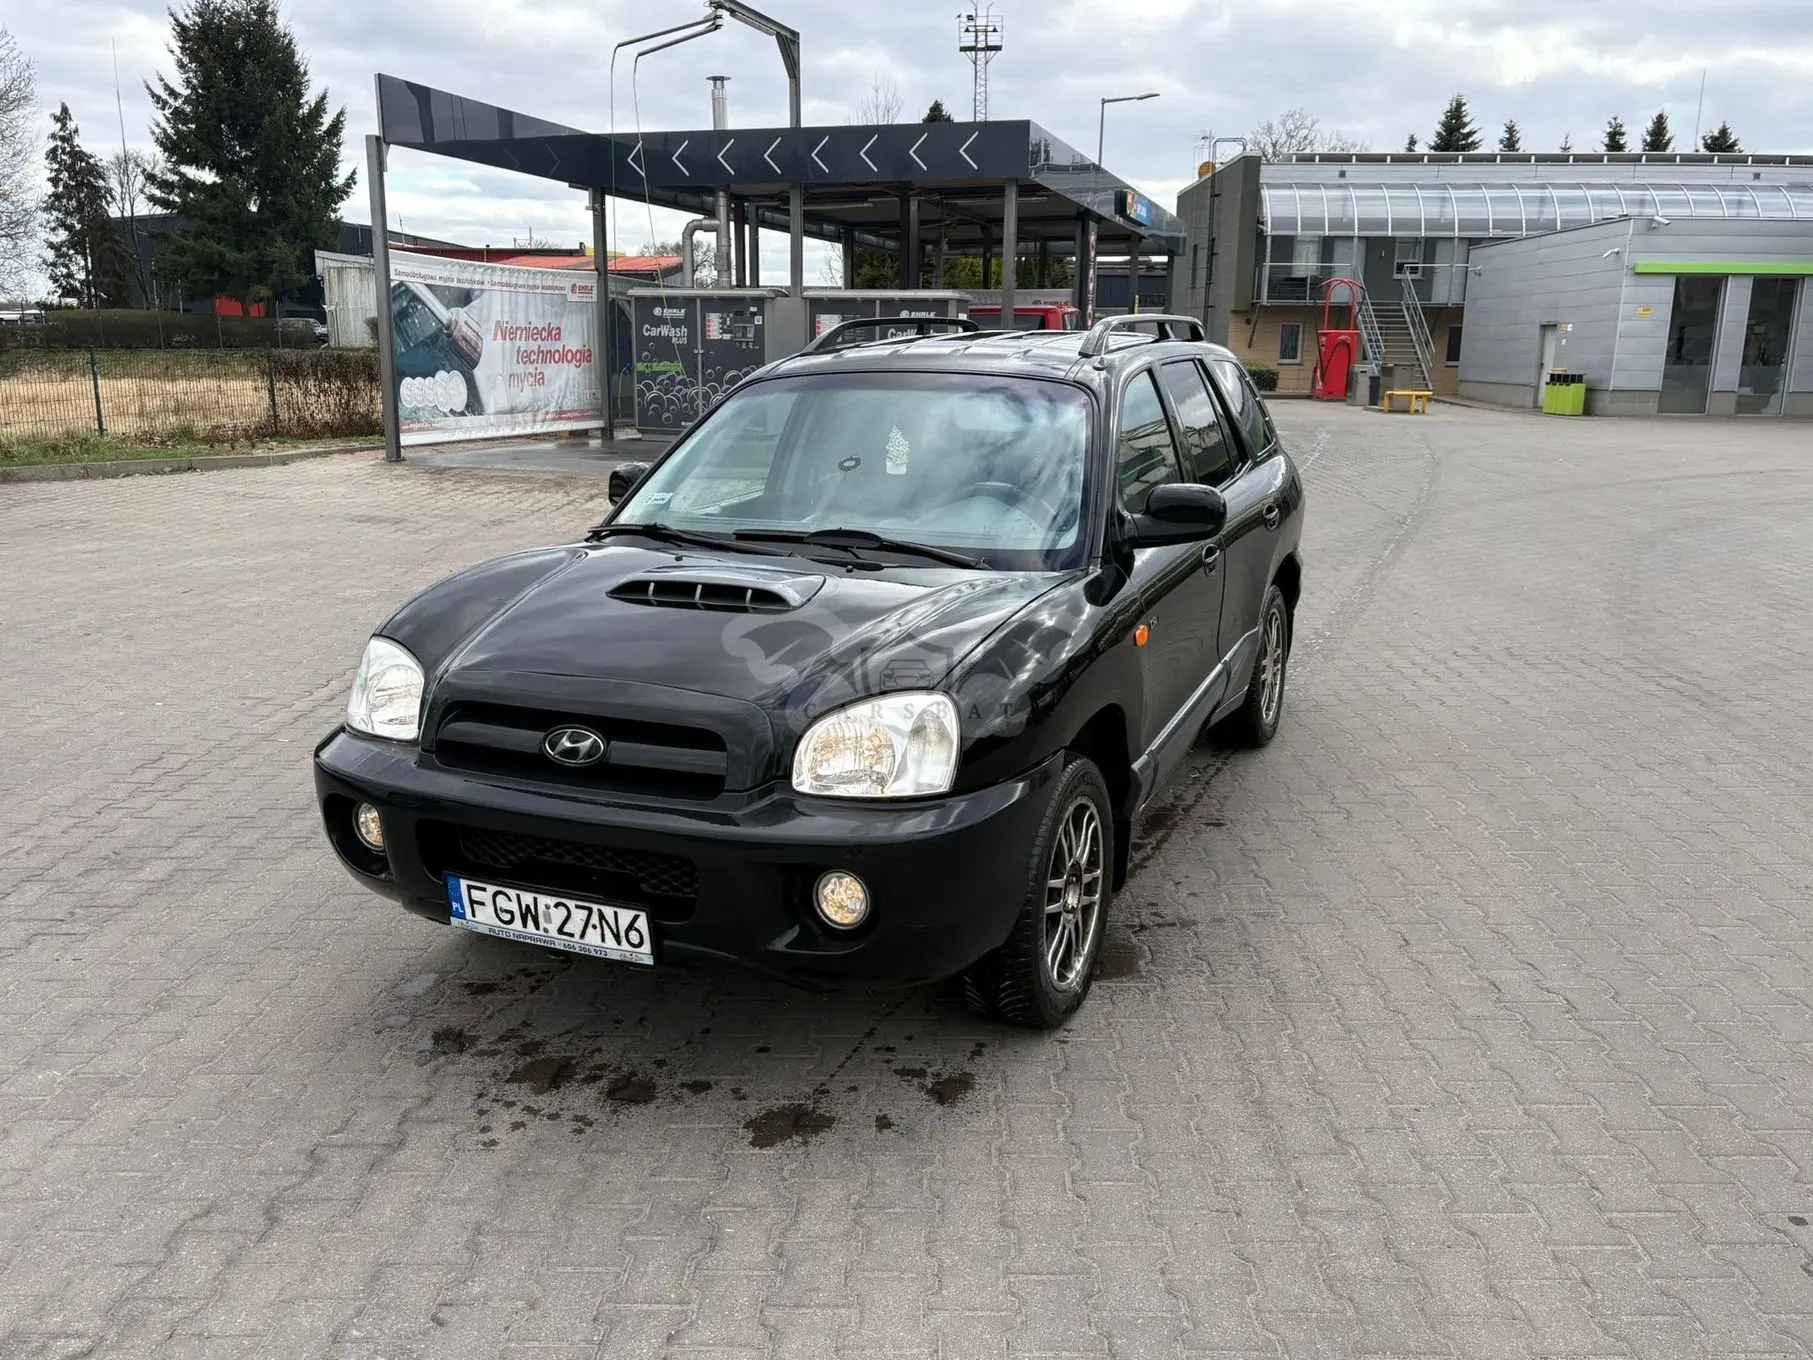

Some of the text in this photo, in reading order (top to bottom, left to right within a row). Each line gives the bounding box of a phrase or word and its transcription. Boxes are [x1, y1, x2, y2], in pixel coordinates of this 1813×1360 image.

[493, 319, 562, 341] Niemiecka
[643, 324, 688, 337] CarWash
[516, 344, 592, 368] technologia
[509, 366, 545, 393] mycia
[452, 902, 464, 913] PL
[466, 883, 645, 949] FGW 27N6
[488, 927, 511, 938] AUTO
[512, 932, 556, 946] NAPRAWA
